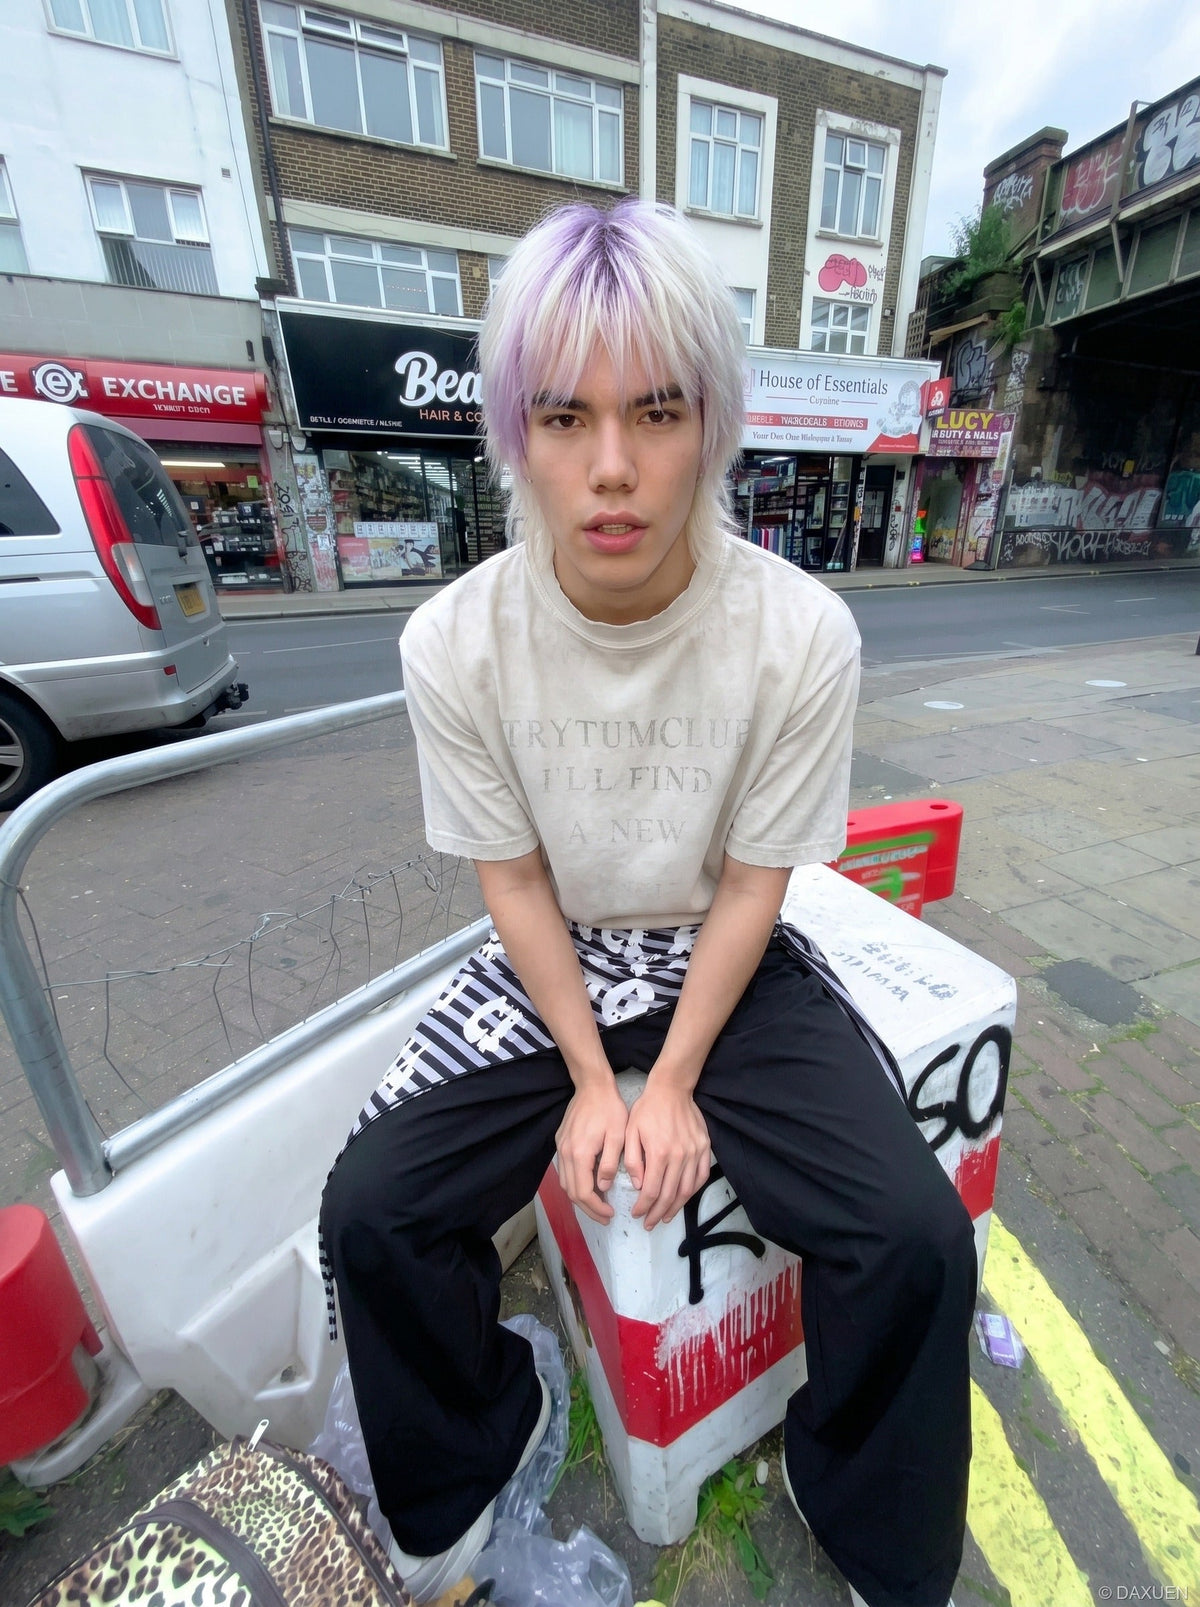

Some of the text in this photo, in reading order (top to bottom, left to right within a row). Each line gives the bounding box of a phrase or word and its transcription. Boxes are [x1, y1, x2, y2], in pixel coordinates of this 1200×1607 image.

[102, 376, 248, 406] EXCHANGE
[759, 369, 889, 395] House of Essentials
[419, 408, 450, 422] HAIR
[453, 411, 463, 423] &
[936, 411, 994, 430] LUCY
[964, 431, 972, 439] &
[973, 431, 999, 440] NAILS
[629, 765, 713, 793] FIND
[568, 819, 686, 844] A NEW
